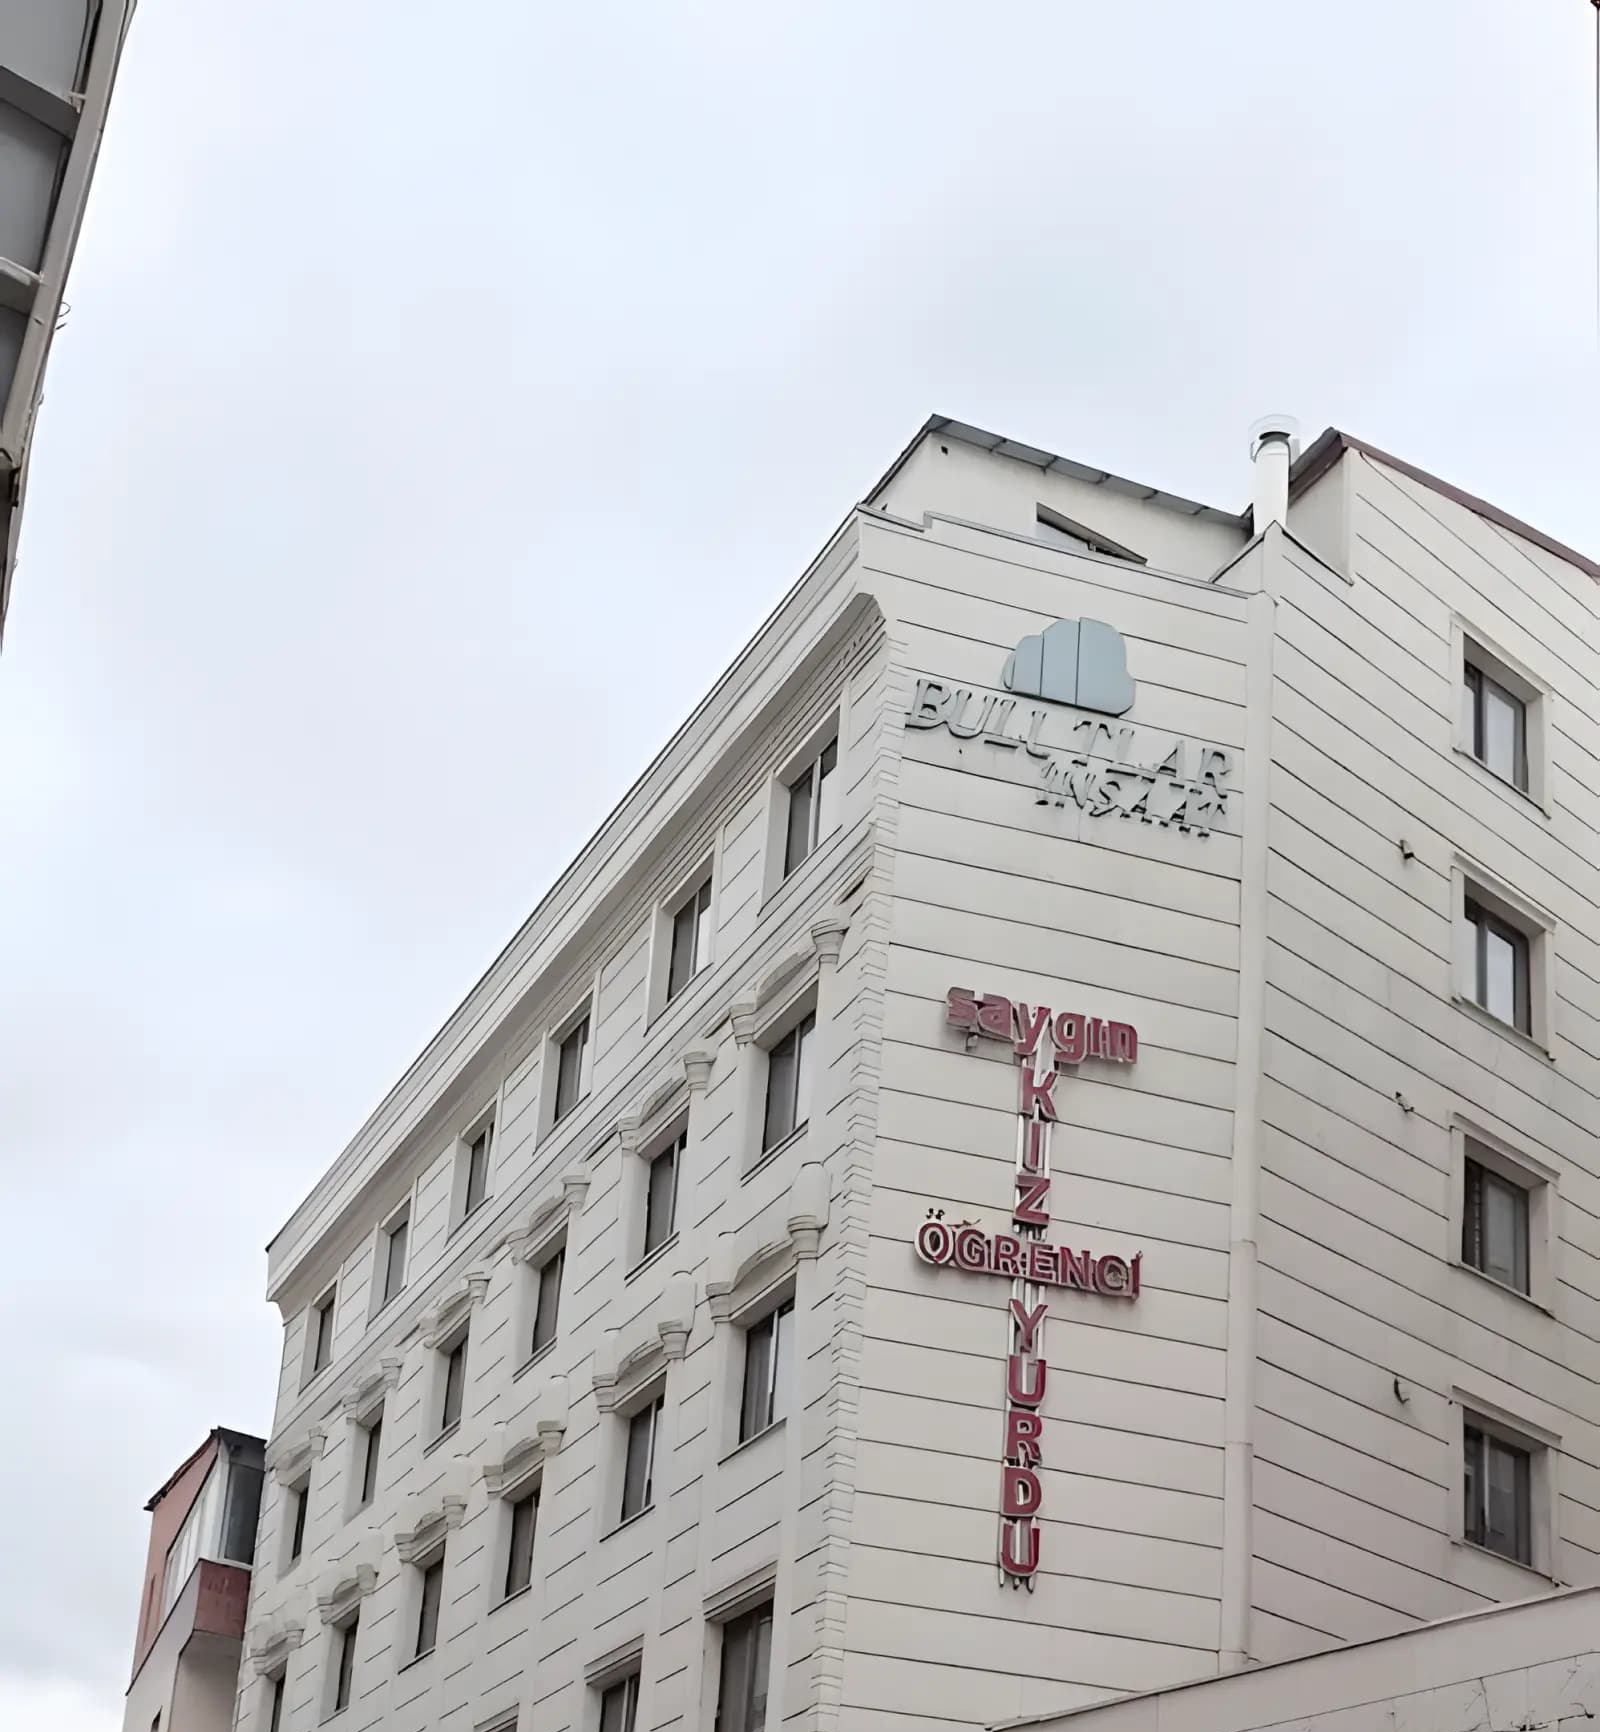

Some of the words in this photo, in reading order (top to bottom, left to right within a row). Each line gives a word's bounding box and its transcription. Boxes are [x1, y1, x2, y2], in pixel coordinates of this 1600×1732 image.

[905, 677, 1232, 798] BULUTLAR
[1012, 1067, 1058, 1226] KIZ
[1000, 1298, 1048, 1577] YURDU
